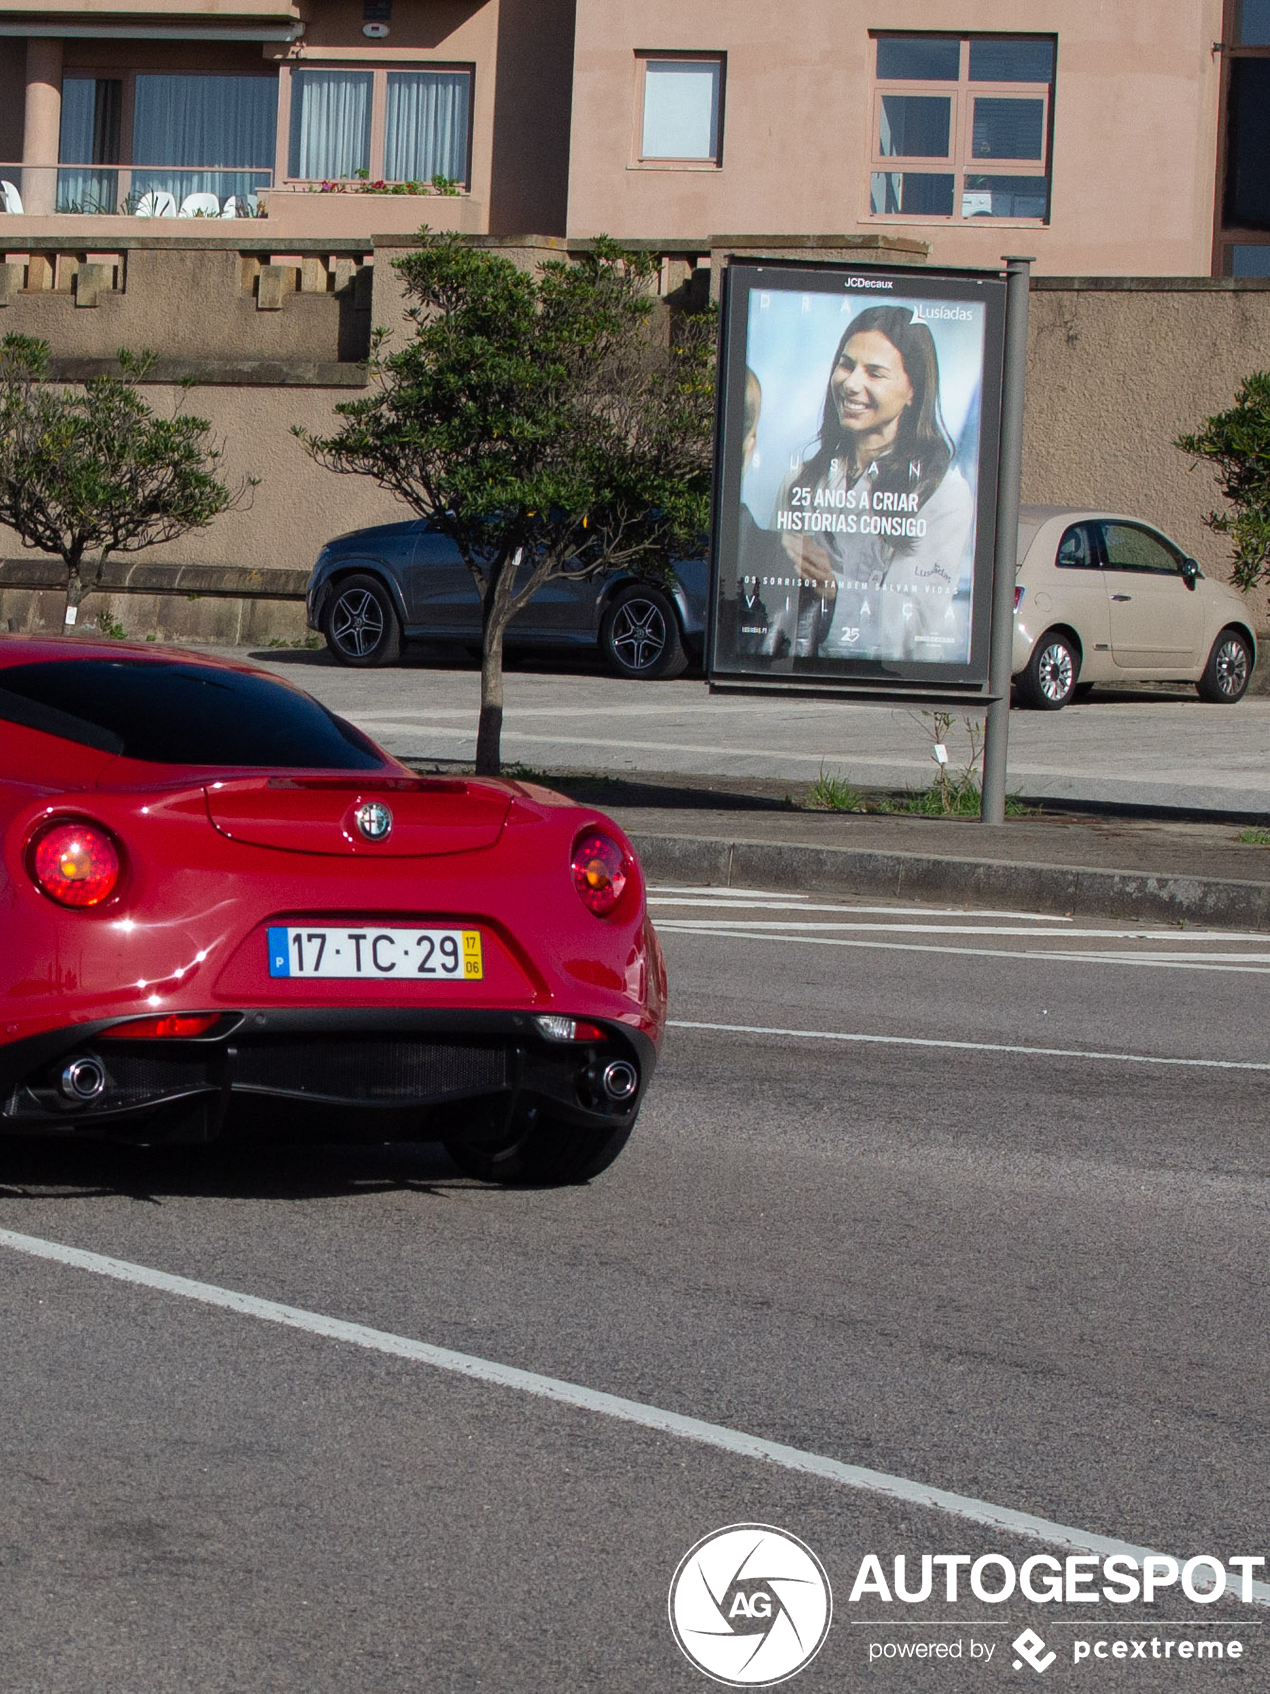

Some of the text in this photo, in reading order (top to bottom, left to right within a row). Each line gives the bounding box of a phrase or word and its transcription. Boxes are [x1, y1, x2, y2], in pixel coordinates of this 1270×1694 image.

[845, 277, 894, 289] JCDecaux
[919, 304, 973, 321] Lusíadas
[791, 487, 919, 512] 25 ANOS A CRIAR
[777, 509, 927, 537] HISTÓRIAS CONSIGO
[744, 575, 958, 595] OS SORRISOS TAMBÉM SALVAM VIDAS
[840, 626, 860, 642] 25
[465, 936, 476, 949] 17
[275, 956, 284, 968] P
[465, 961, 479, 974] 06
